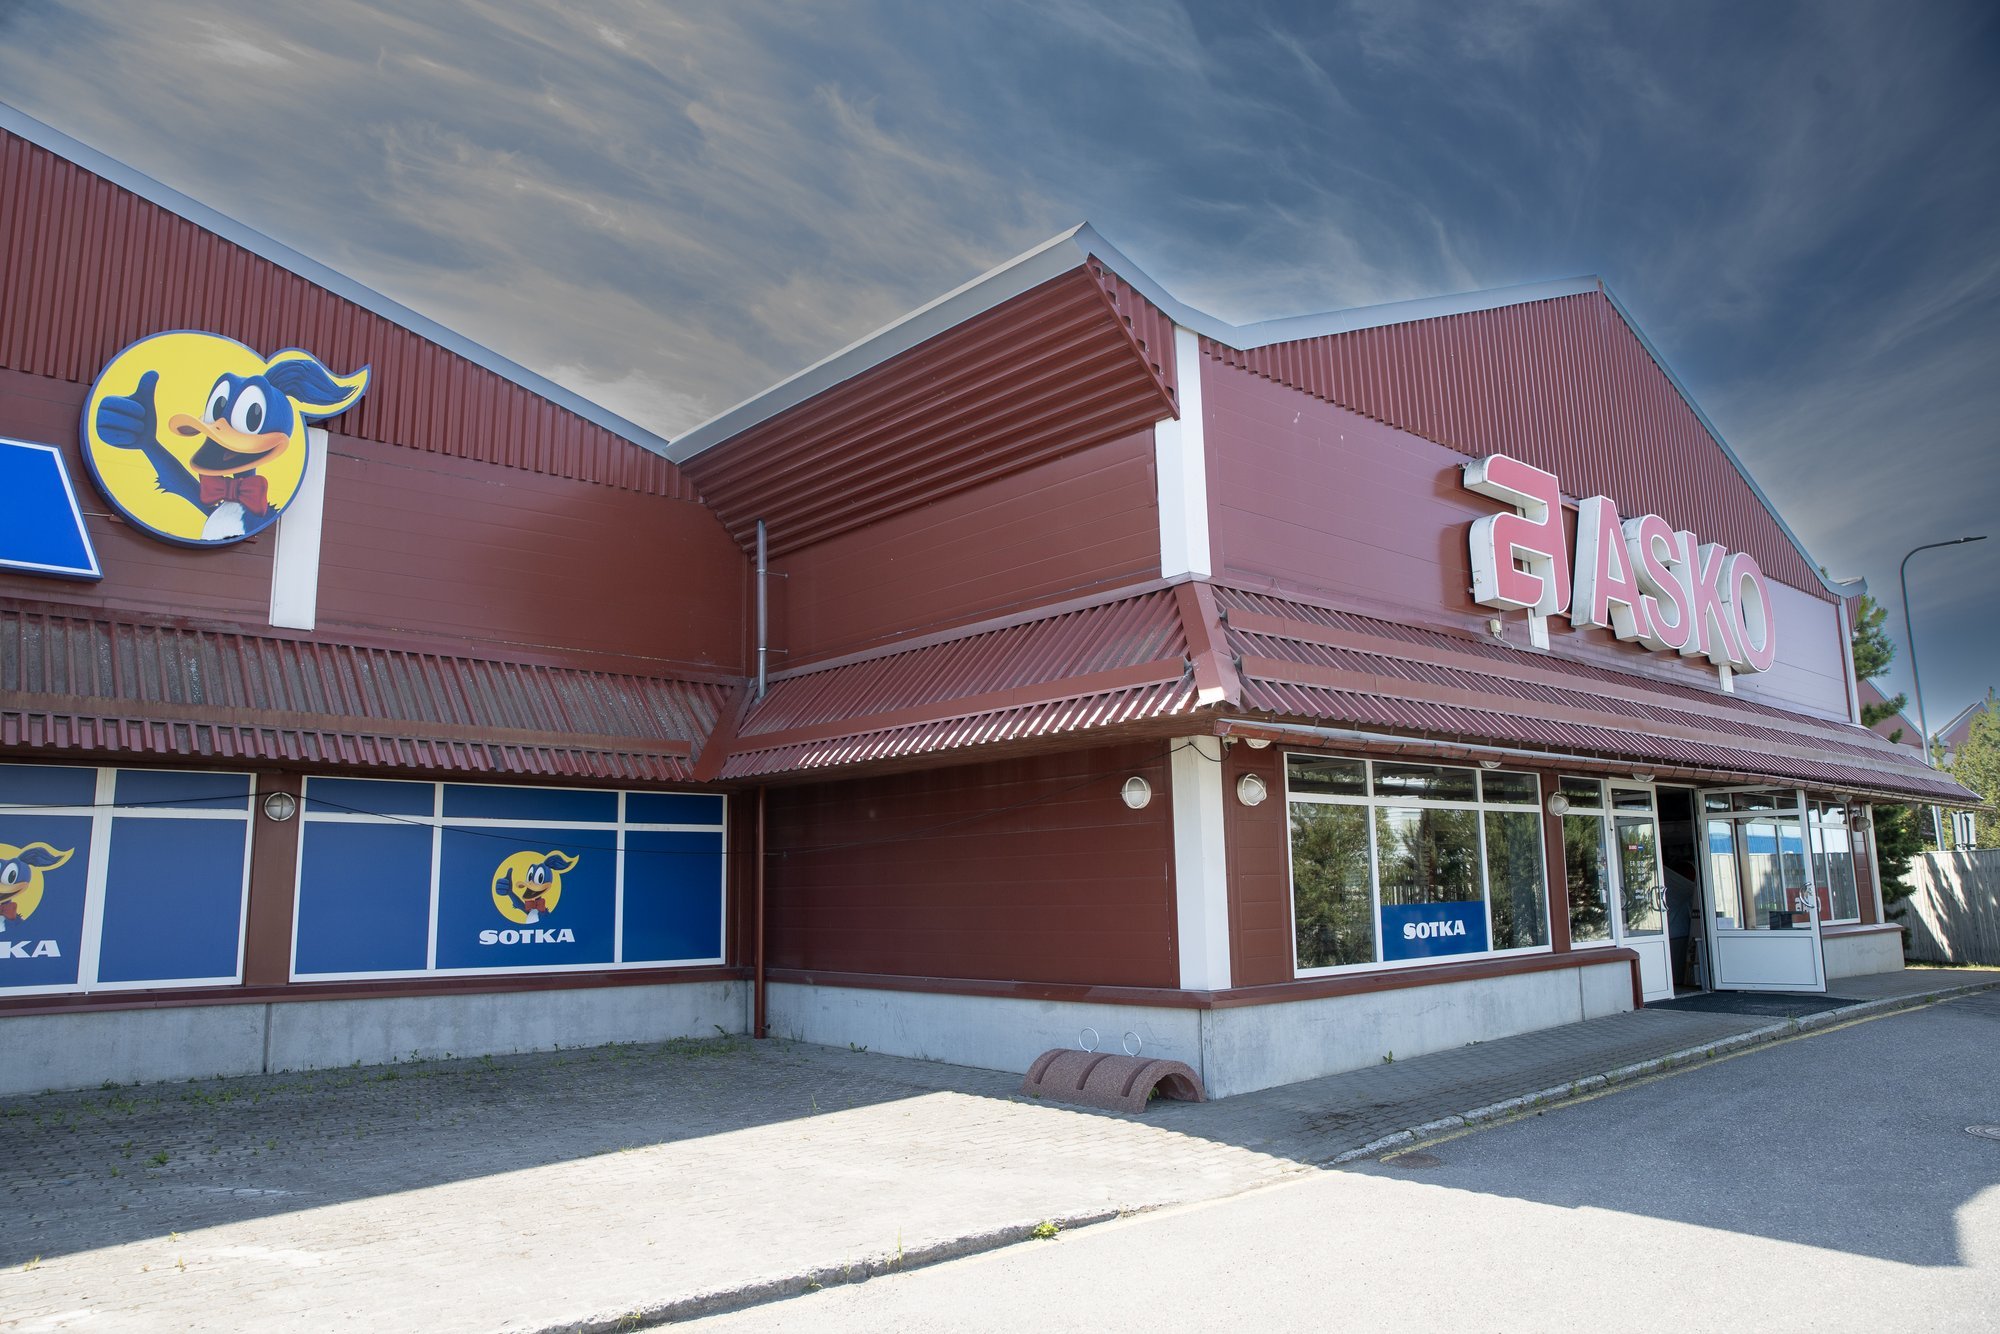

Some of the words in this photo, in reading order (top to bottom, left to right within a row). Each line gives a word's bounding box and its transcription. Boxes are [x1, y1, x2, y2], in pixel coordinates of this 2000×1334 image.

[1573, 494, 1776, 674] ASKO
[479, 928, 576, 945] SOTKA
[1403, 919, 1466, 940] SOTKA
